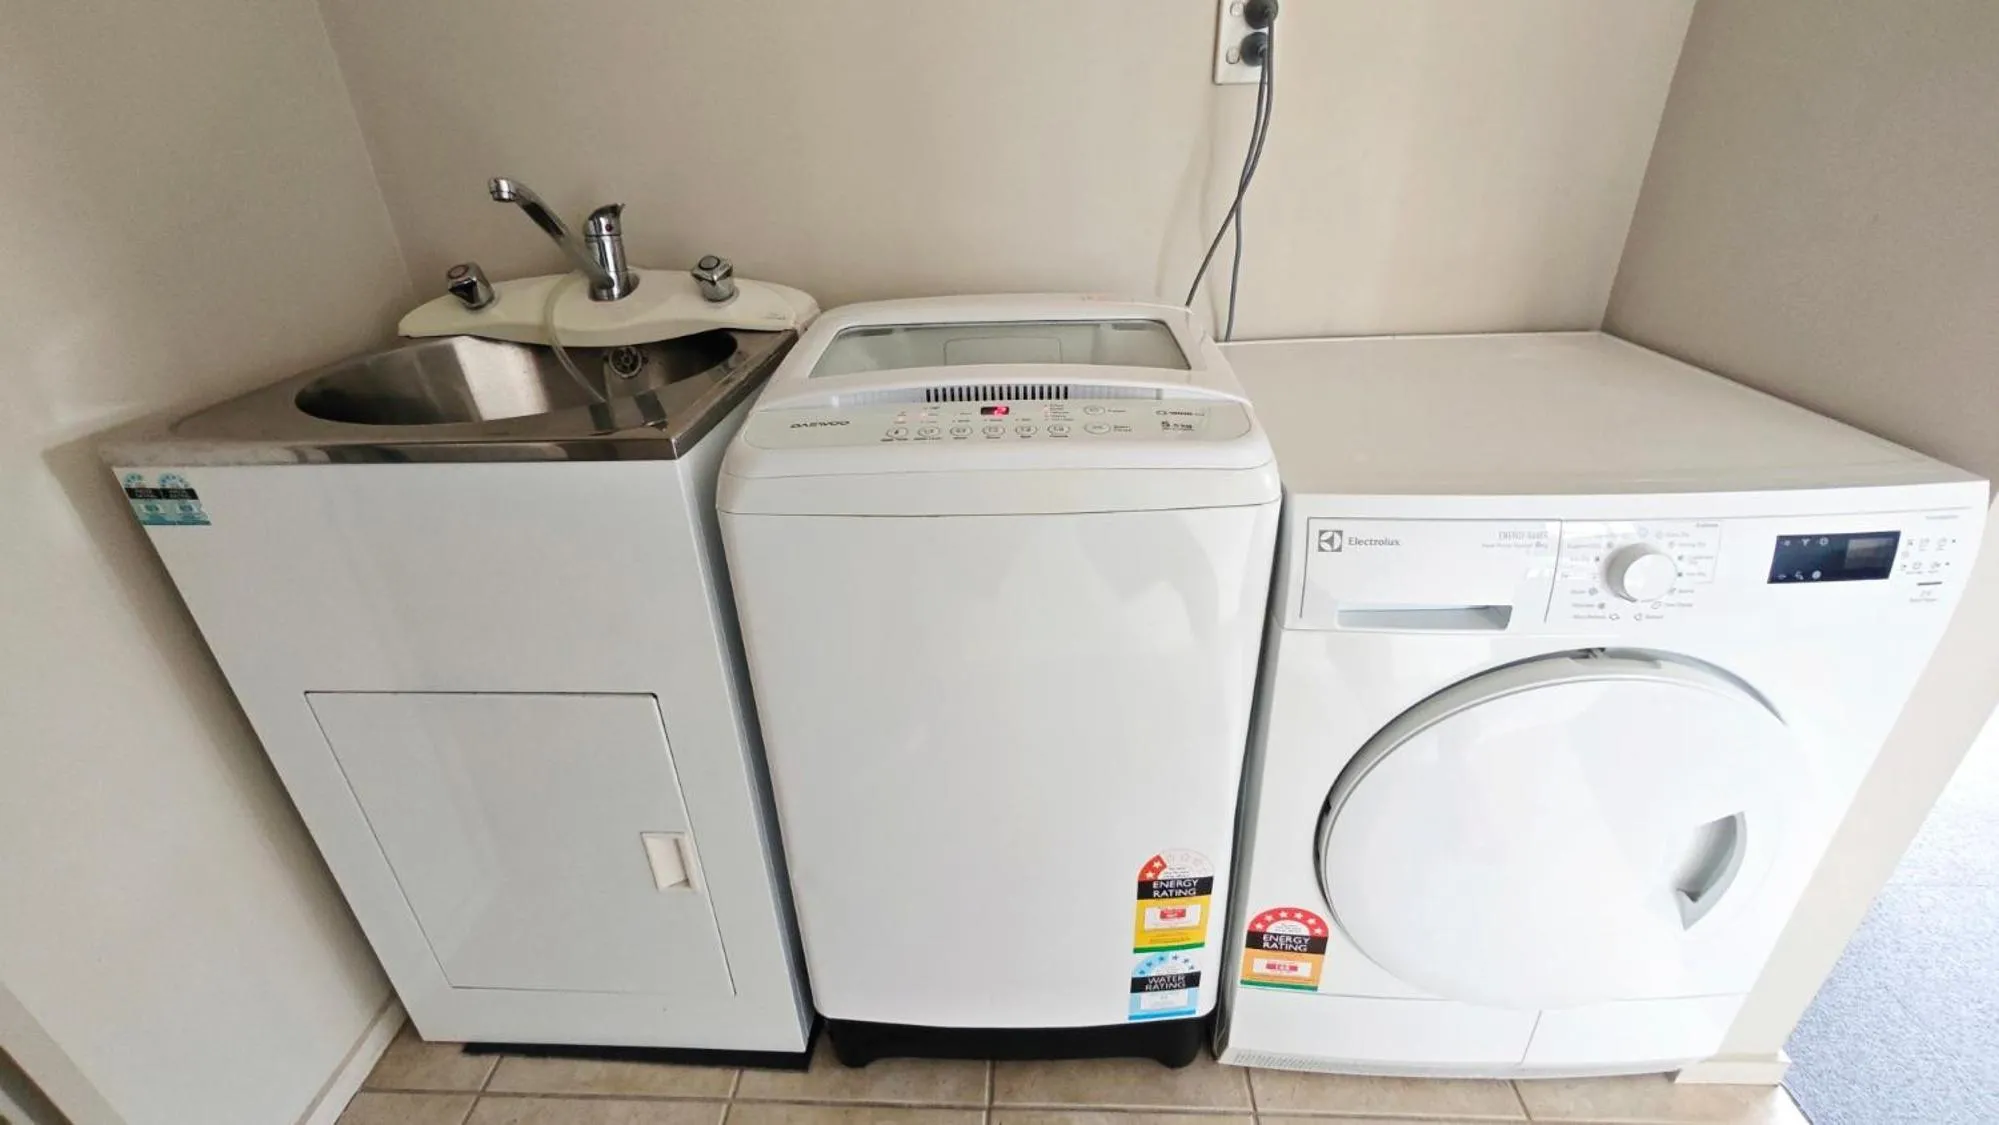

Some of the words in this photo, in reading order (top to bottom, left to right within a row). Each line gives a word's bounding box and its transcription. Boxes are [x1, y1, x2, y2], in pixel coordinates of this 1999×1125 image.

[790, 420, 850, 429] DAEWOO
[1347, 536, 1401, 546] Electrolux
[1152, 879, 1199, 889] ENERGY
[1153, 888, 1197, 898] RATING
[1262, 934, 1311, 944] ENERGY
[1262, 942, 1308, 952] RATING
[1148, 974, 1186, 984] WATER
[1145, 982, 1187, 992] RATING
